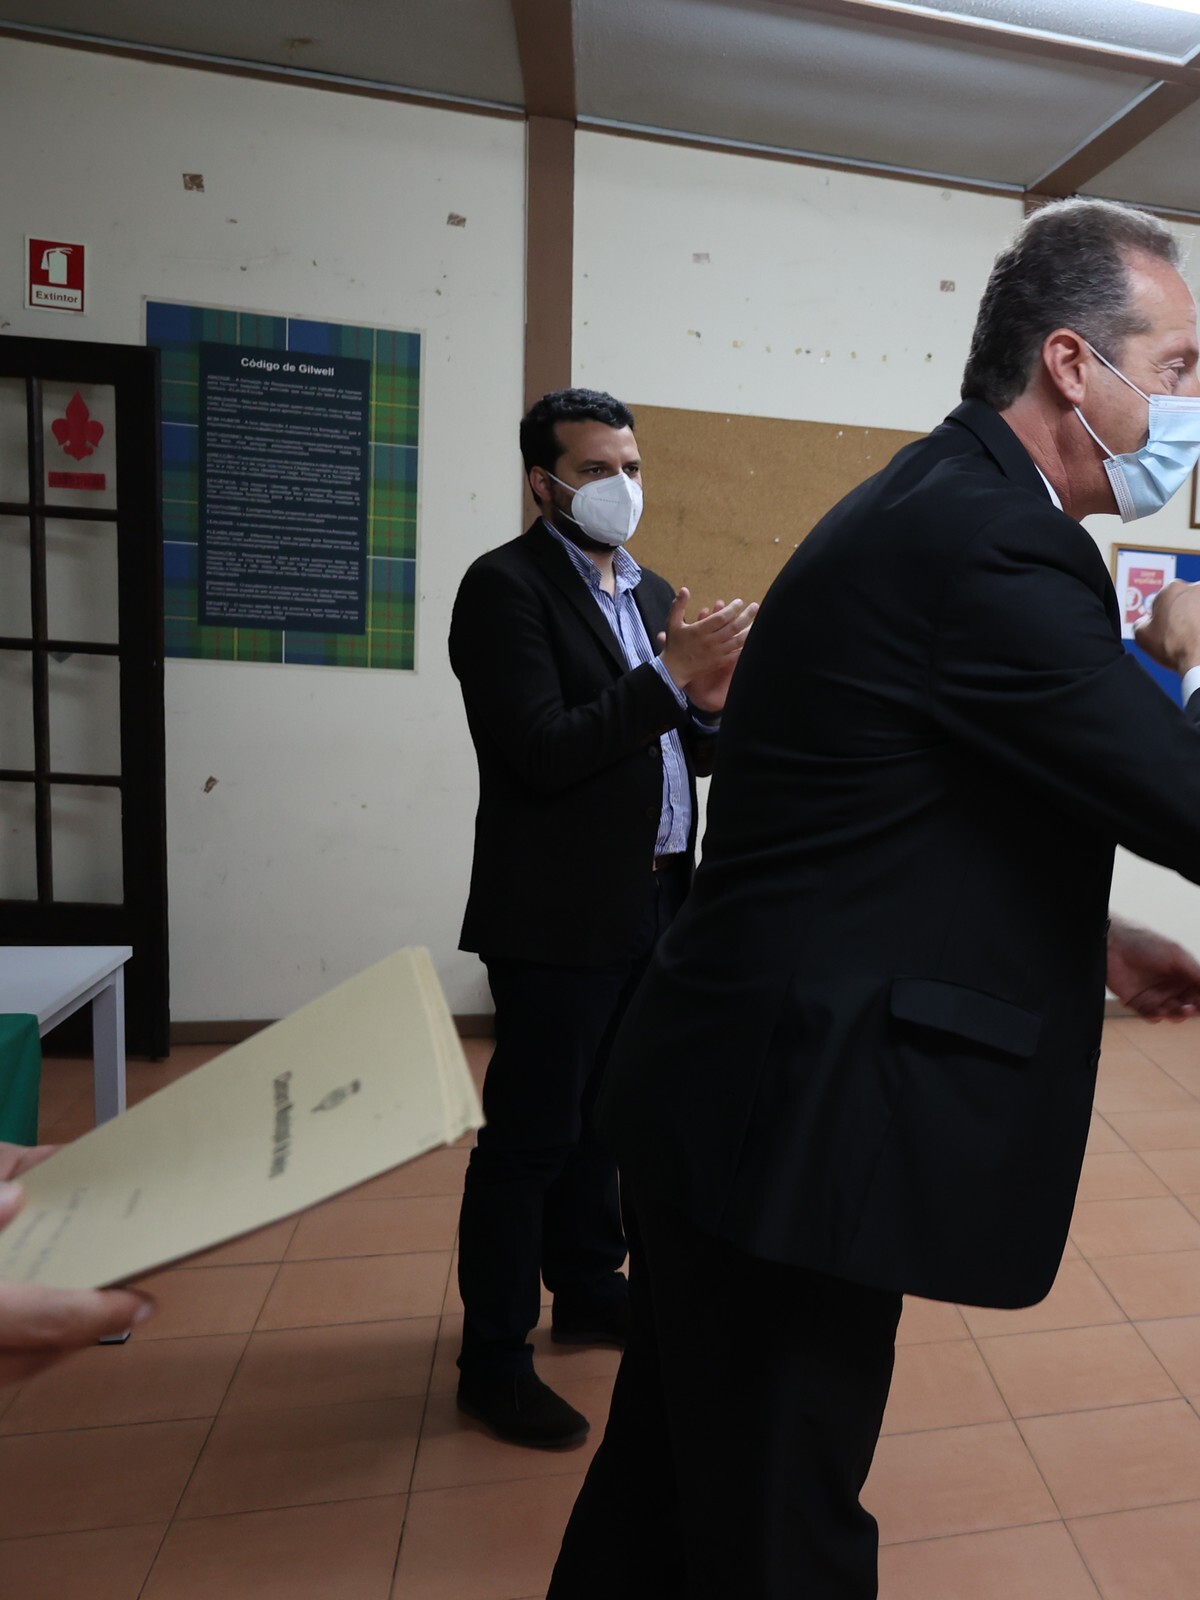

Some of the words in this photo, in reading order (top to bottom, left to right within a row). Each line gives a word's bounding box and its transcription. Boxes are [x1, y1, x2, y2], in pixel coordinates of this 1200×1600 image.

[35, 290, 79, 304] Extintor
[240, 357, 280, 372] Código
[282, 362, 296, 373] de
[298, 364, 335, 377] Gilwell
